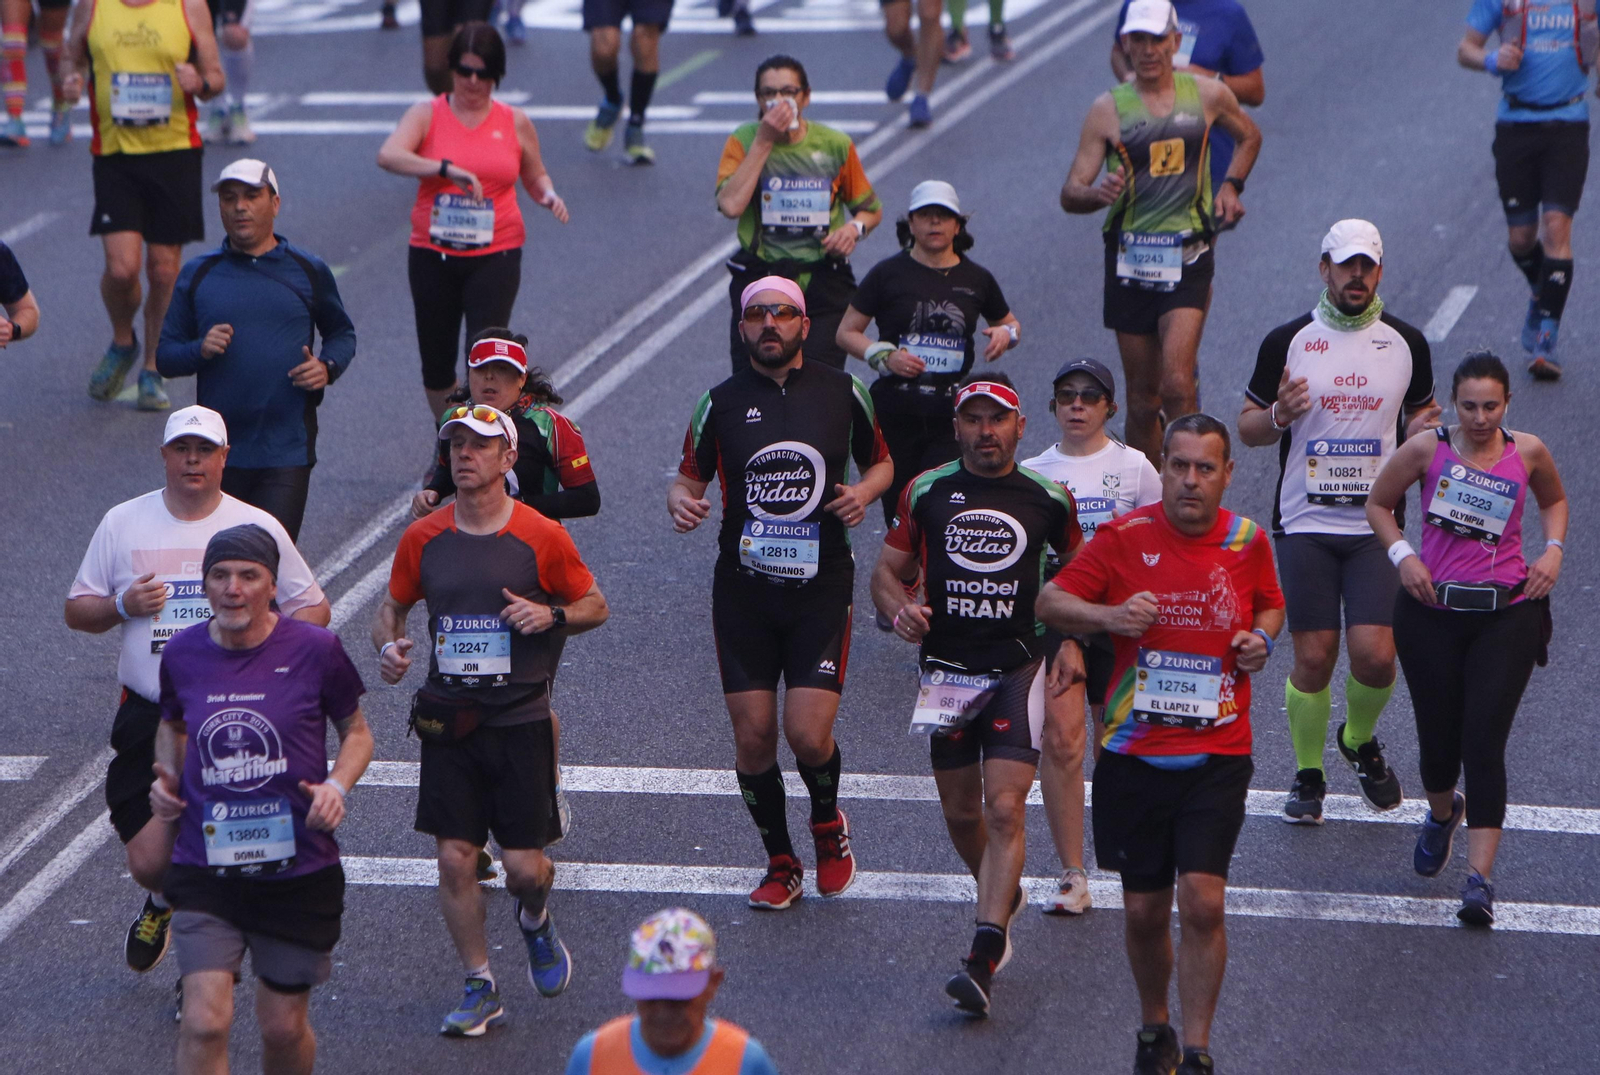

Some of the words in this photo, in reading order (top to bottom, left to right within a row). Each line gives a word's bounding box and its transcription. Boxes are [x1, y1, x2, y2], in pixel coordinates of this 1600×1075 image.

[785, 180, 822, 189] ZURICH
[780, 199, 812, 208] 13243
[781, 215, 810, 223] MYLENE
[1136, 234, 1175, 245] ZURICH
[1133, 252, 1164, 263] 12243
[922, 335, 958, 348] ZURICH
[1305, 338, 1329, 354] edp
[1334, 372, 1368, 389] edp
[1332, 444, 1373, 453] ZURICH
[745, 465, 812, 483] Donando
[1328, 467, 1362, 478] 10821
[1319, 483, 1340, 492] LOLO
[1342, 481, 1370, 492] NÚÑEZ
[1467, 472, 1511, 494] ZURICH
[746, 481, 810, 504] Vidas
[1457, 492, 1493, 511] 13223
[1450, 510, 1485, 527] OLYMPIA
[766, 525, 810, 537] ZURICH
[944, 524, 1013, 539] Donando
[760, 546, 798, 558] 12813
[945, 536, 1012, 555] Vidas
[751, 560, 805, 576] SABORIANOS
[178, 585, 205, 596] ZUR
[946, 578, 1019, 596] mobel
[172, 607, 211, 619] 12165
[947, 596, 1015, 619] FRAN
[455, 619, 500, 630] ZURICH
[1171, 617, 1201, 627] LUNA
[452, 642, 489, 653] 12247
[461, 663, 479, 672] JON
[1164, 656, 1212, 671] ZURICH
[946, 674, 990, 688] ZURICH
[1157, 679, 1197, 694] 12754
[1151, 700, 1161, 709] EL
[1164, 701, 1190, 712] LAPIZ
[1193, 704, 1200, 714] V
[222, 712, 244, 722] CITY
[201, 758, 288, 787] Marathon
[230, 802, 281, 818] ZURICH
[227, 828, 270, 842] 13803
[234, 849, 267, 862] DONAL
